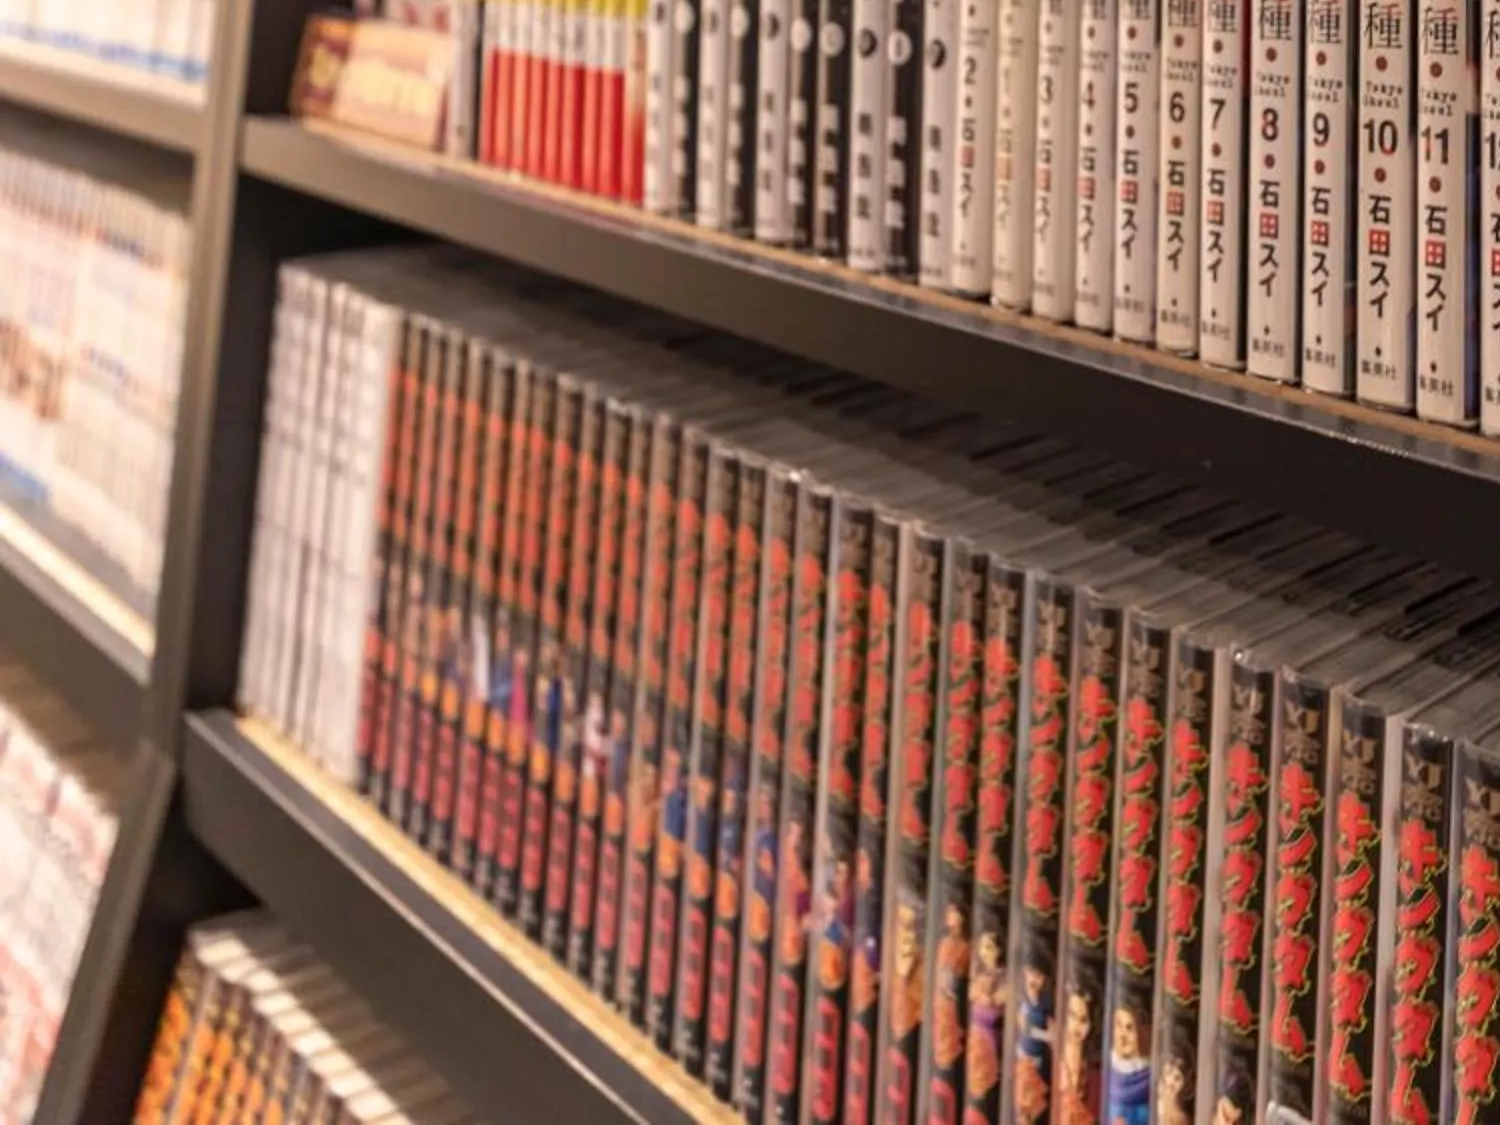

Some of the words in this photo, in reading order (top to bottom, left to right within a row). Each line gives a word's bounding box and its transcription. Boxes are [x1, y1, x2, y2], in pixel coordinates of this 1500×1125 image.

[1125, 83, 1138, 113] 5
[1170, 92, 1185, 123] 6
[1210, 99, 1226, 130] 7
[1261, 108, 1279, 141] 8
[1313, 113, 1329, 146] 9
[1363, 119, 1398, 155] 10
[1421, 125, 1449, 164] 11
[1167, 160, 1185, 271] 石田スイ
[1207, 169, 1225, 282] 石田スイ
[1258, 181, 1280, 297] 石田スイ
[1311, 187, 1331, 306] 石田スイ
[1368, 195, 1391, 318] 石田スイ
[1425, 205, 1447, 331] 石田スイ
